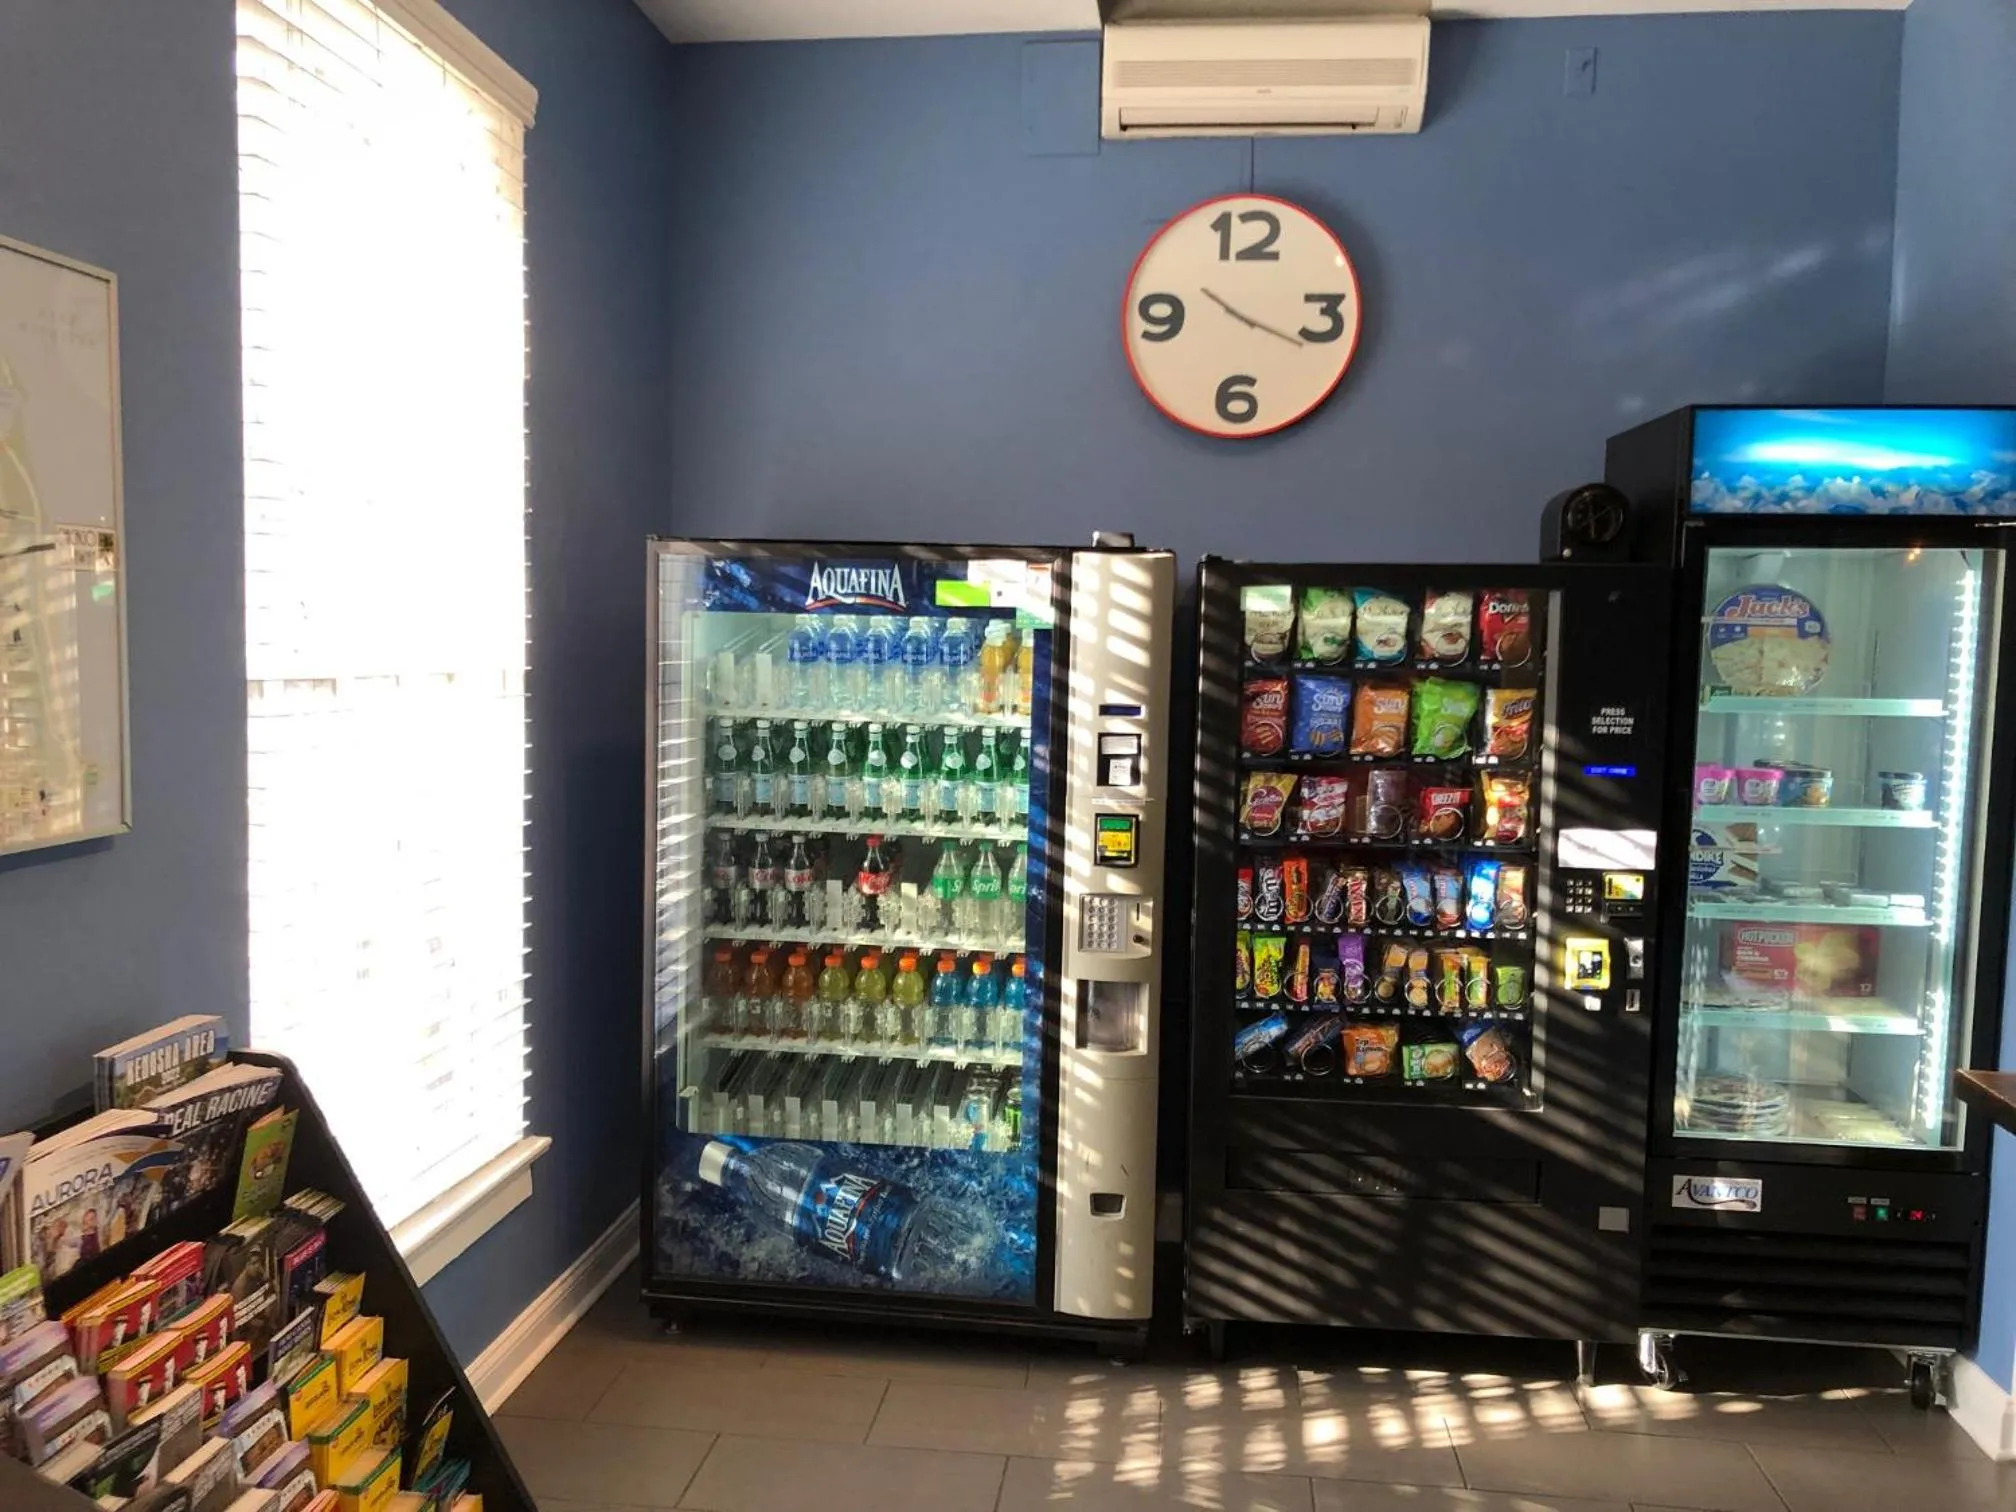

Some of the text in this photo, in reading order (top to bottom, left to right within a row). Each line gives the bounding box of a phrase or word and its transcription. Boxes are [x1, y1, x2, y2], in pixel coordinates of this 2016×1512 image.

[1209, 210, 1281, 262] 12
[1137, 292, 1186, 343] 9
[1298, 292, 1347, 344] 3
[1214, 374, 1259, 424] 6
[805, 561, 907, 608] AQUAFINA
[1591, 716, 1635, 726] SELECTION
[1592, 726, 1633, 735] FOR PRICE
[1600, 707, 1626, 716] PRESS
[126, 1030, 216, 1087] KENOSHA AREA
[205, 1081, 273, 1121] RACINE
[30, 1162, 114, 1212] AURORA
[819, 1172, 879, 1260] AQUAFINA
